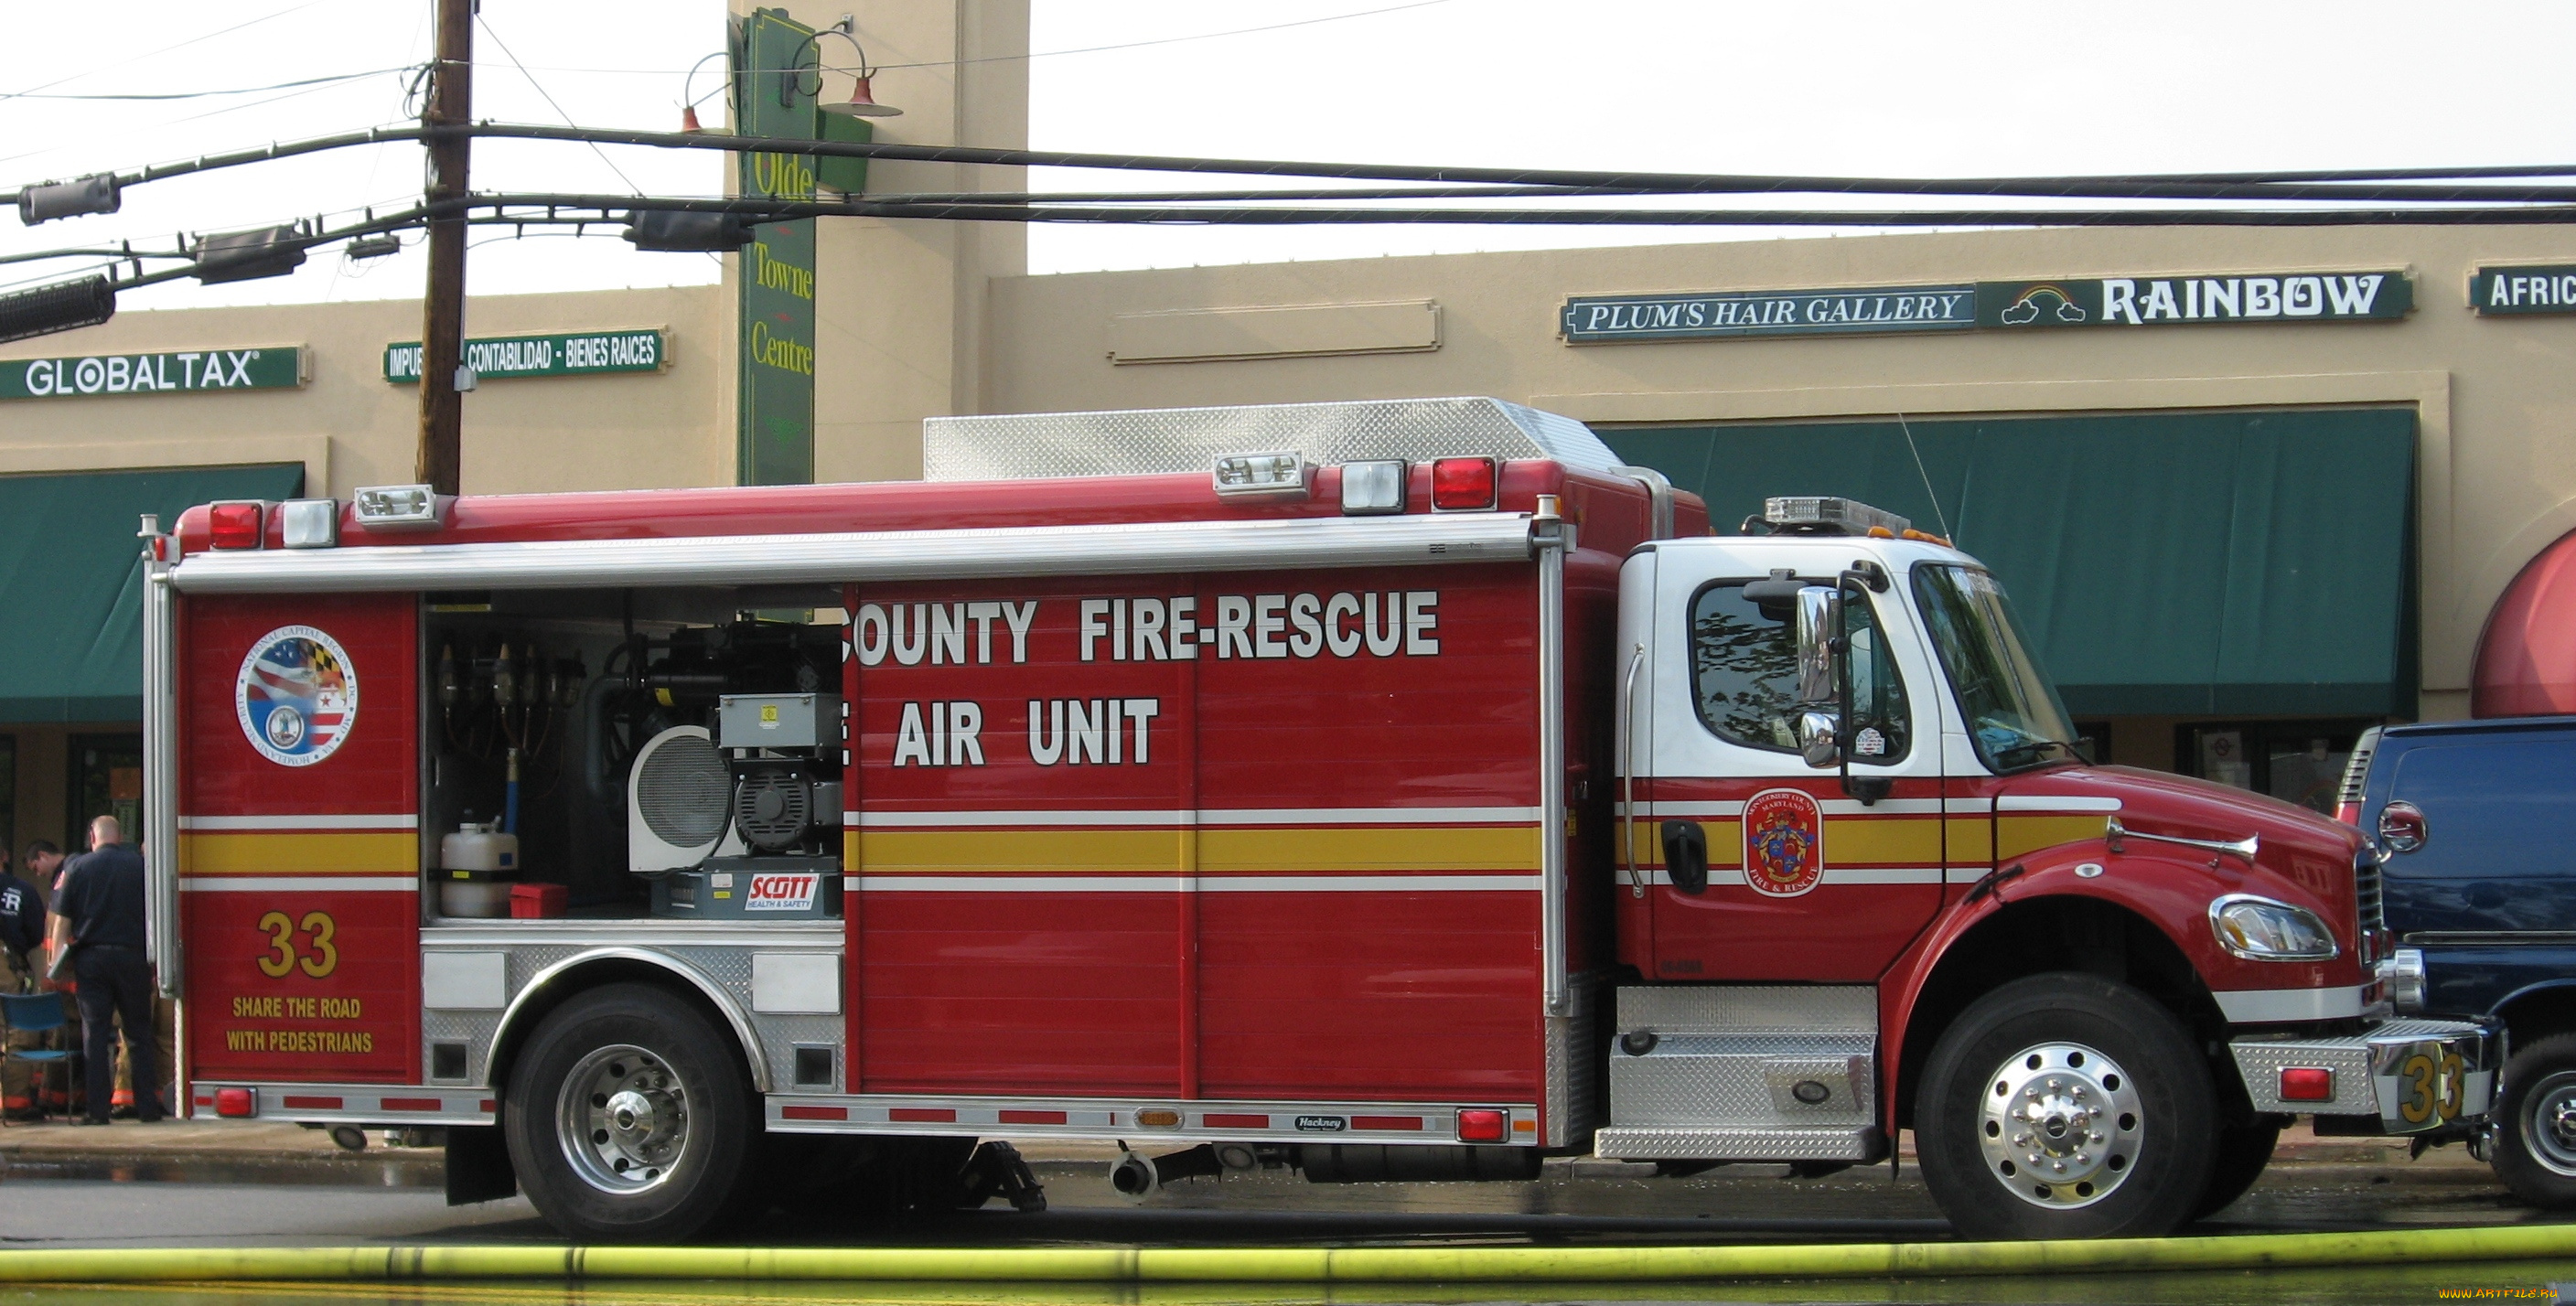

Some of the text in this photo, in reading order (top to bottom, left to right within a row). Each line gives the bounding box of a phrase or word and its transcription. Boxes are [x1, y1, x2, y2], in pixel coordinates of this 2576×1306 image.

[754, 152, 813, 203] Olde
[754, 241, 813, 300] Towne
[2101, 274, 2384, 326] RAINBOW
[2490, 274, 2576, 306] AFRIC
[1586, 294, 1962, 330] PLUM'S HAIR GALLERY
[467, 340, 552, 372] CONTABILIDAD
[565, 337, 609, 368] BIENES
[611, 335, 655, 365] RAICES
[751, 321, 812, 376] Centre
[1079, 590, 1441, 662] FIRE-RESCUE
[242, 626, 349, 671] NATIONAL CAPITAL REGION
[893, 701, 985, 766] AIR
[1028, 698, 1158, 765] UNIT
[257, 742, 309, 765] HOMELAND
[1747, 793, 1816, 816] MONTGOMERY COUNTY
[1761, 800, 1805, 812] MARYLAND
[749, 876, 813, 899] SCOTT
[1749, 866, 1818, 893] FIRE & RESCUE
[747, 900, 775, 908] HEALTH
[783, 900, 811, 908] SAFETY
[257, 910, 338, 980] 33
[232, 997, 361, 1019] SHARE THE ROAD
[226, 1031, 372, 1053] WITH PEDESTRIANS
[2399, 1053, 2463, 1123] 33
[1299, 1118, 1342, 1129] Hackney
